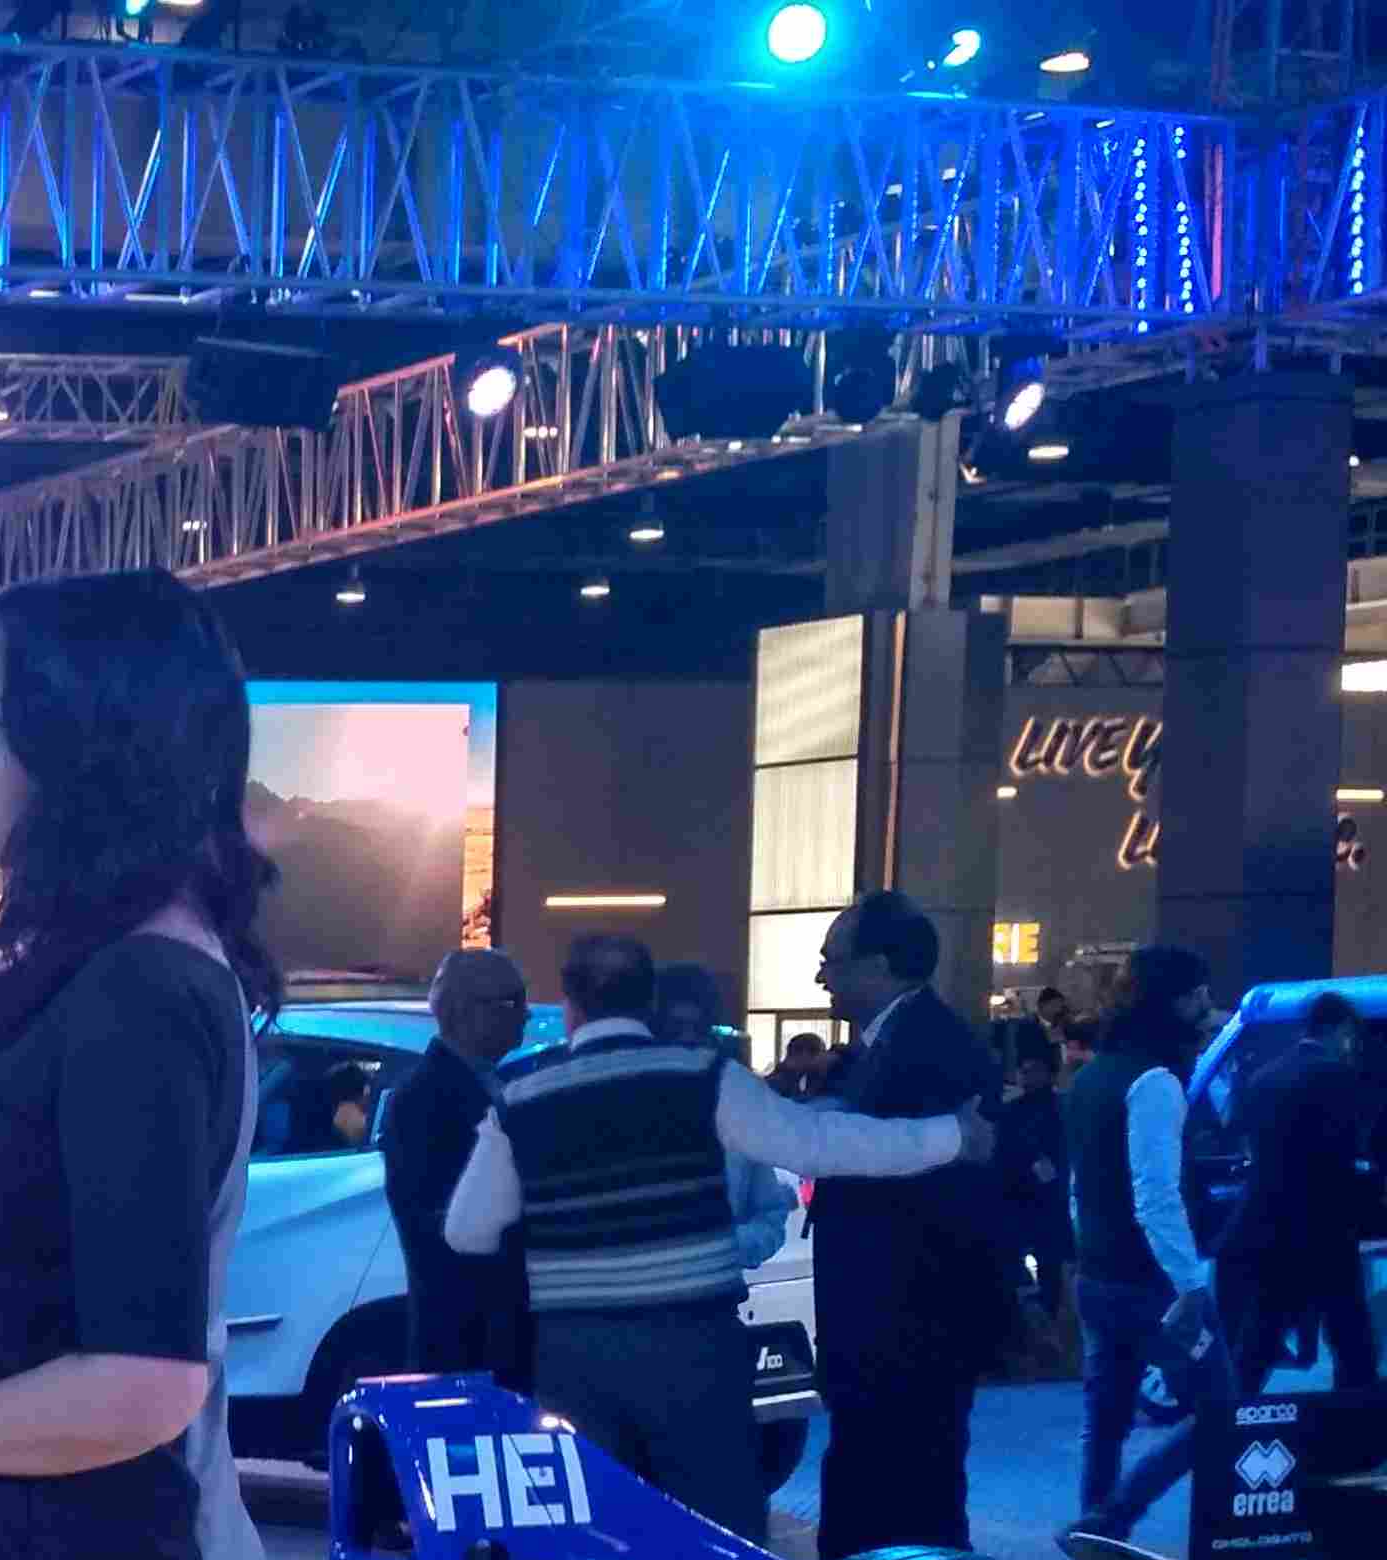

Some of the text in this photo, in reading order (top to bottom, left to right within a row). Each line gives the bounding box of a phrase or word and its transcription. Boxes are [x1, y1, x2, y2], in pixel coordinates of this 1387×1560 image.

[1235, 1403, 1298, 1425] sparco
[427, 1433, 591, 1532] HEI
[1233, 1489, 1295, 1517] errea
